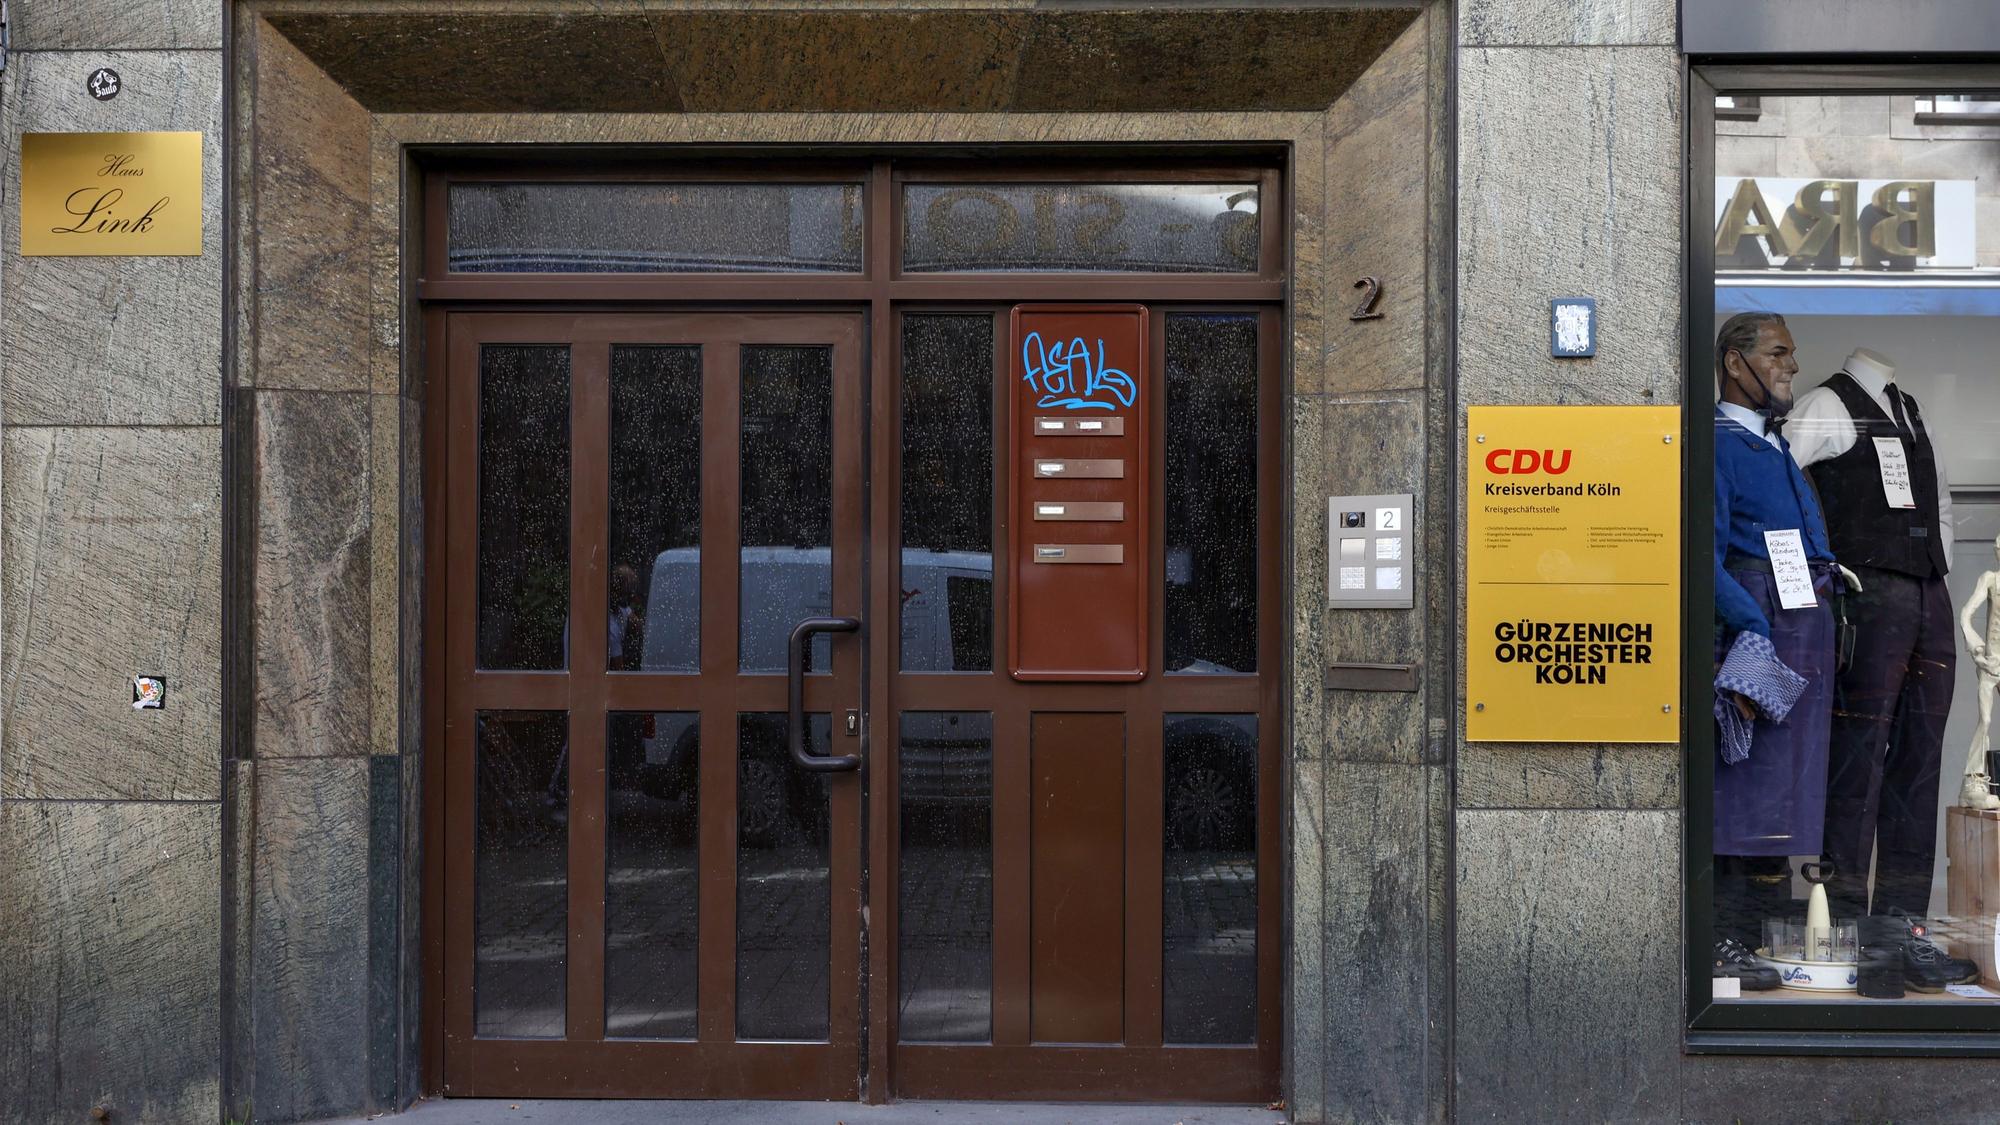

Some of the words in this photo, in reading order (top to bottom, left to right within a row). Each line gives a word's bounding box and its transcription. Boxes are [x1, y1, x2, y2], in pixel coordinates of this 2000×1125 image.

[97, 154, 145, 178] Haus
[51, 187, 170, 234] Link
[1349, 275, 1385, 322] 2
[1485, 448, 1572, 475] CDU
[1485, 482, 1583, 496] Kreisverband
[1587, 482, 1621, 496] Köln
[1383, 510, 1394, 529] 2
[1484, 505, 1560, 515] Kreisgeschäftsstelle
[1495, 618, 1653, 643] GÜRZENICH
[1495, 643, 1652, 664] ORCHESTER
[1535, 662, 1606, 684] KÖLN
